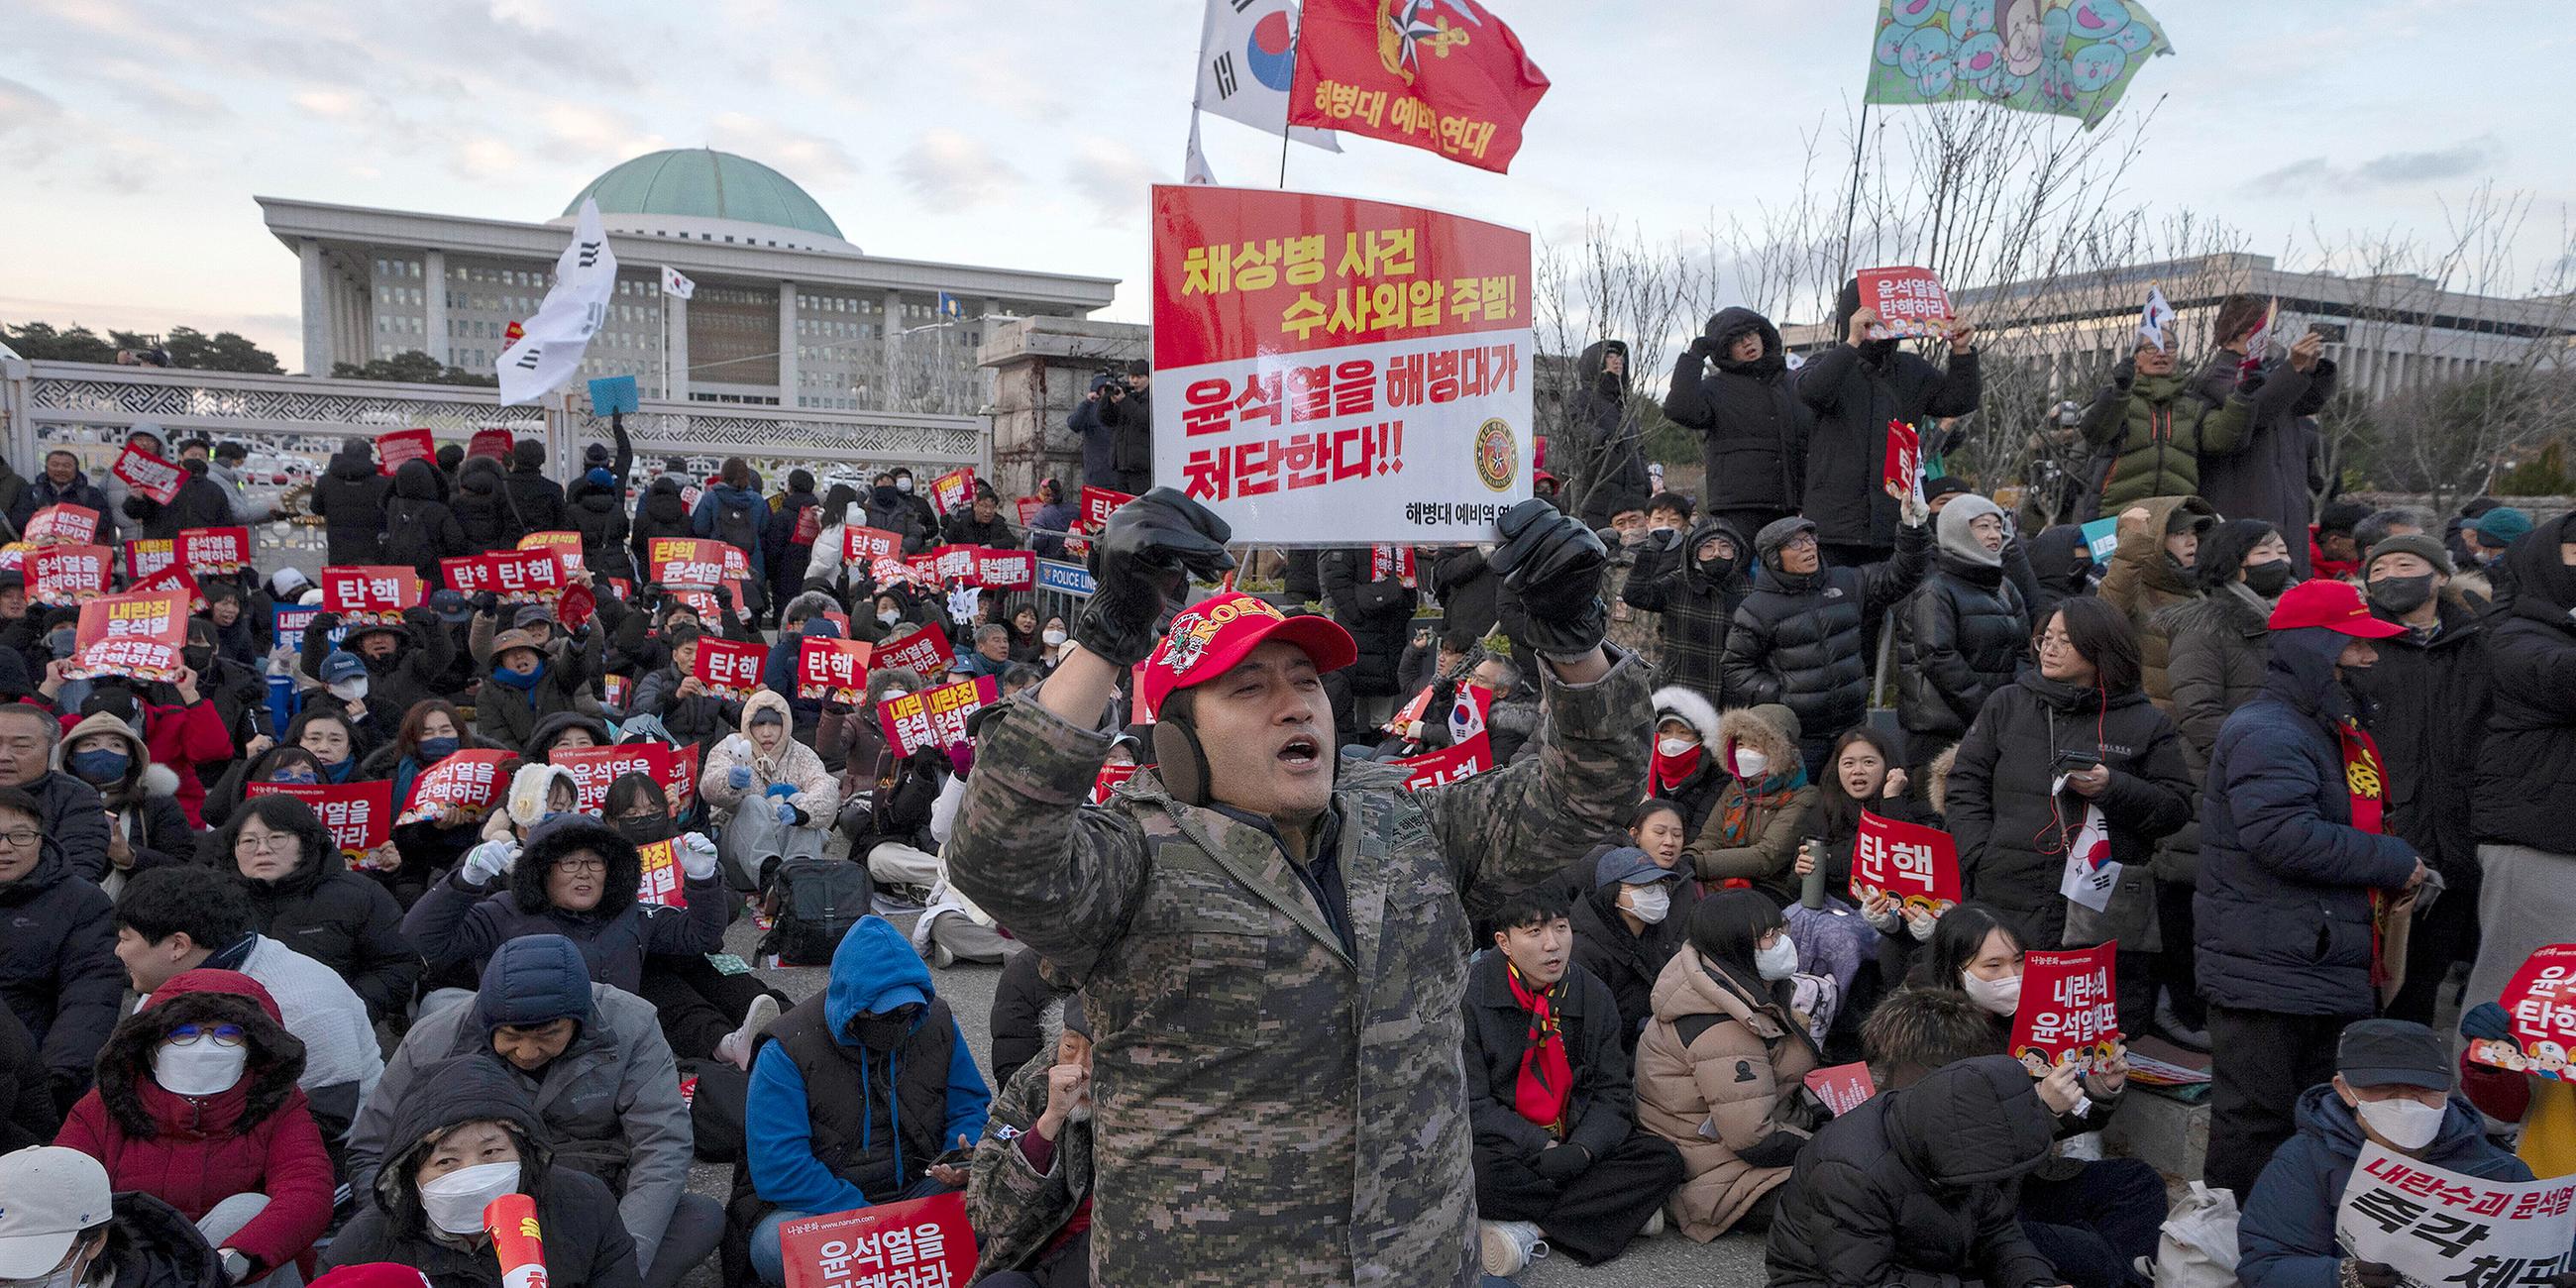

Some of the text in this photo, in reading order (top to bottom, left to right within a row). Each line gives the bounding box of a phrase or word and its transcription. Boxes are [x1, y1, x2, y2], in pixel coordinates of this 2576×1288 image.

[1316, 79, 1387, 128] 해병대
[1440, 116, 1497, 159] 연대
[1182, 228, 1416, 296] 채상병 사건
[1878, 278, 1941, 299] 윤석열을
[1281, 274, 1517, 341] 수사외압 주범!
[1880, 298, 1945, 319] 탄핵하라
[1182, 344, 1518, 438] 윤석열을 해병대가
[1183, 420, 1403, 502] 처단한다!!
[1406, 502, 1451, 525] 해병대
[1455, 503, 1494, 526] 예비역
[187, 536, 237, 552] 윤석열을
[654, 541, 698, 563] 탄핵
[851, 535, 890, 556] 탄핵
[37, 555, 99, 577] 윤석열을
[187, 550, 238, 564] 탄핵하라
[38, 573, 100, 593] 탄핵하라
[498, 558, 555, 590] 탄핵
[663, 562, 722, 584] 윤석열
[1052, 570, 1079, 587] POLICE
[337, 578, 399, 607] 탄핵
[109, 598, 171, 619] 내란죄
[107, 617, 168, 638] 윤석열
[84, 652, 170, 670] 탄핵하라
[85, 641, 173, 660] 윤석열을
[882, 638, 934, 668] 윤석열을
[708, 653, 759, 685] 탄핵
[807, 651, 853, 685] 탄핵
[926, 681, 980, 714] 내란죄
[421, 761, 495, 786] 윤석열을
[414, 782, 491, 805] 탄핵하라
[330, 824, 369, 847] 하라
[1860, 832, 1934, 892] 탄핵
[2527, 966, 2576, 998] 윤
[2363, 1157, 2576, 1220] 내란수괴 윤석열
[820, 1216, 875, 1230] www.nanum.com
[2349, 1188, 2492, 1258] 즉각
[818, 1223, 945, 1280] 윤석열을
